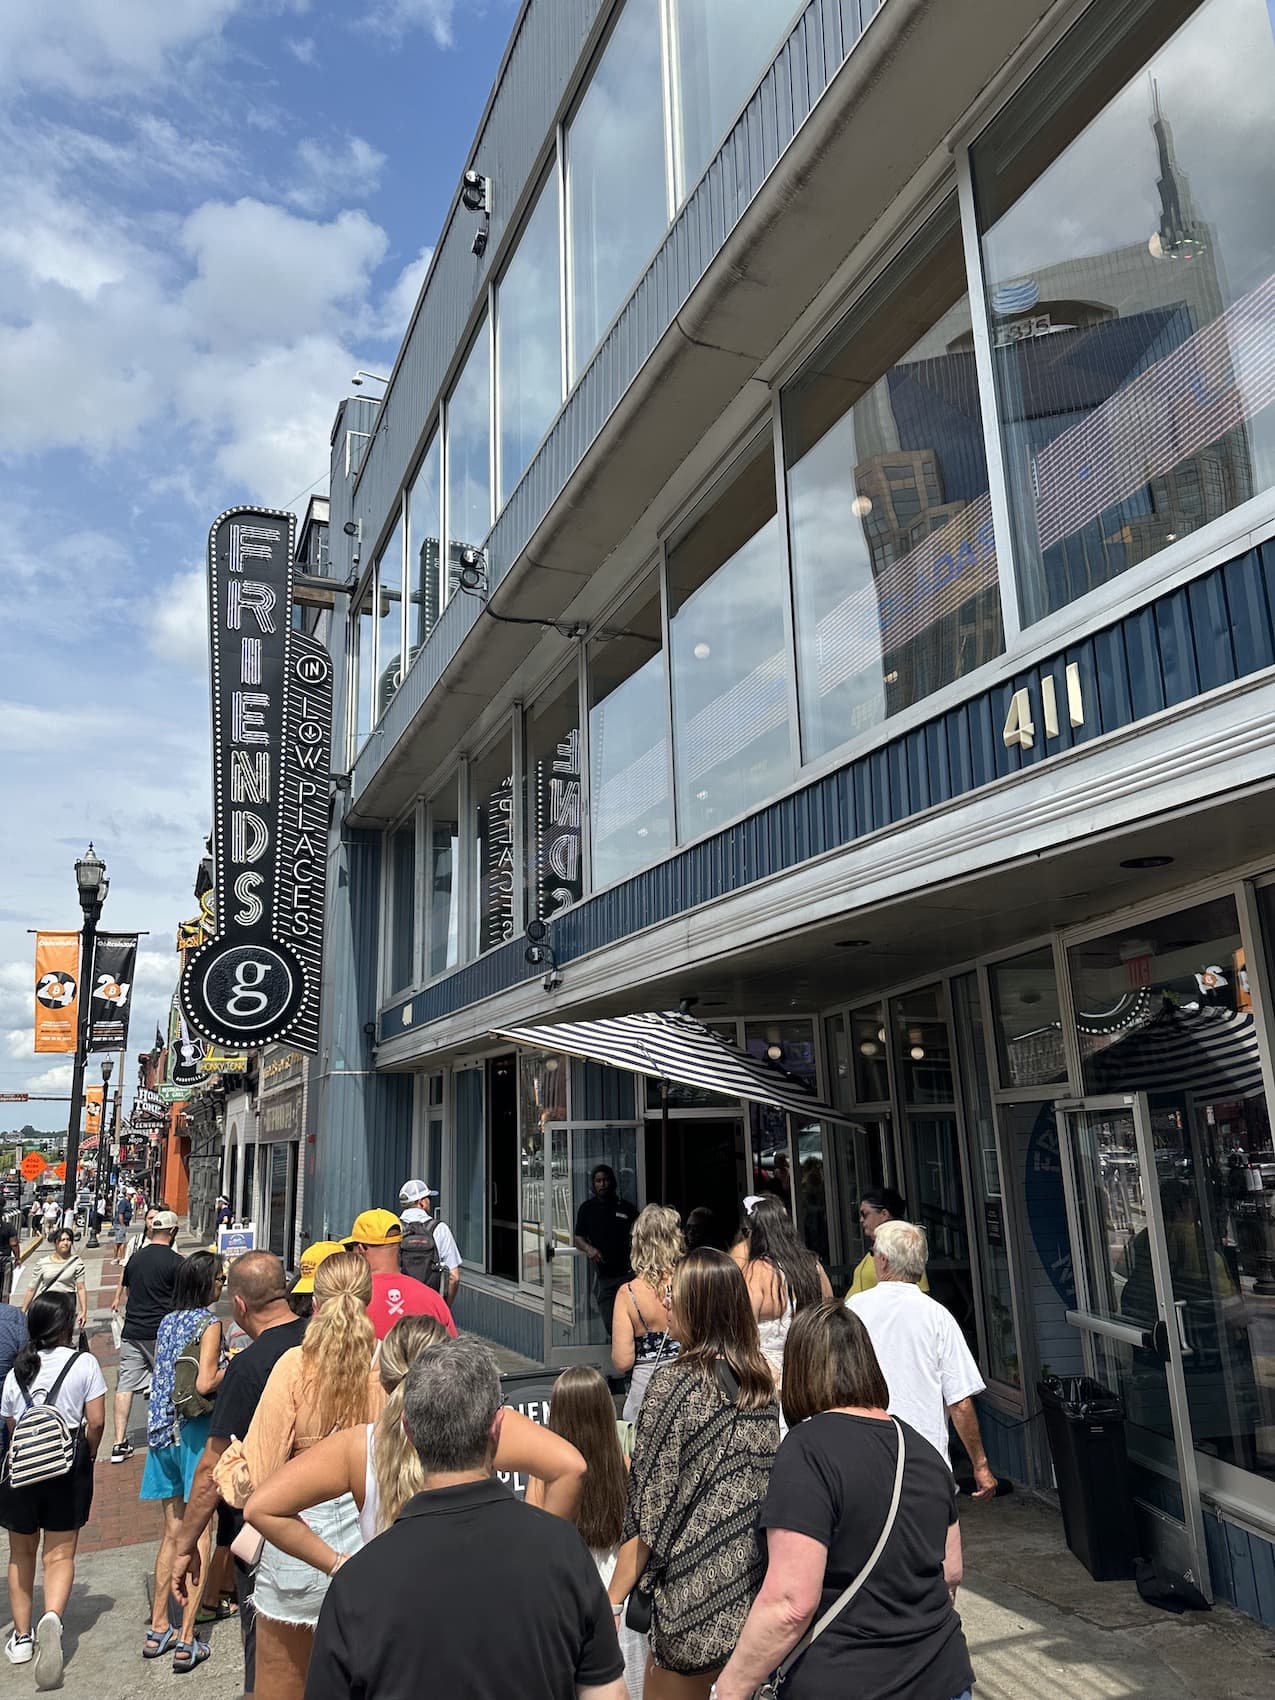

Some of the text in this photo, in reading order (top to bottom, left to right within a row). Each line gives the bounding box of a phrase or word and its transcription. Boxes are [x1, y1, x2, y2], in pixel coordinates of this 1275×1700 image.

[227, 524, 281, 927] FRIENDS
[1003, 661, 1084, 750] 411
[292, 661, 322, 936] IN LOW PLACES
[37, 973, 76, 1006] 24
[92, 974, 131, 1007] 24
[226, 960, 272, 1017] g
[200, 1061, 245, 1071] HONKY TONK
